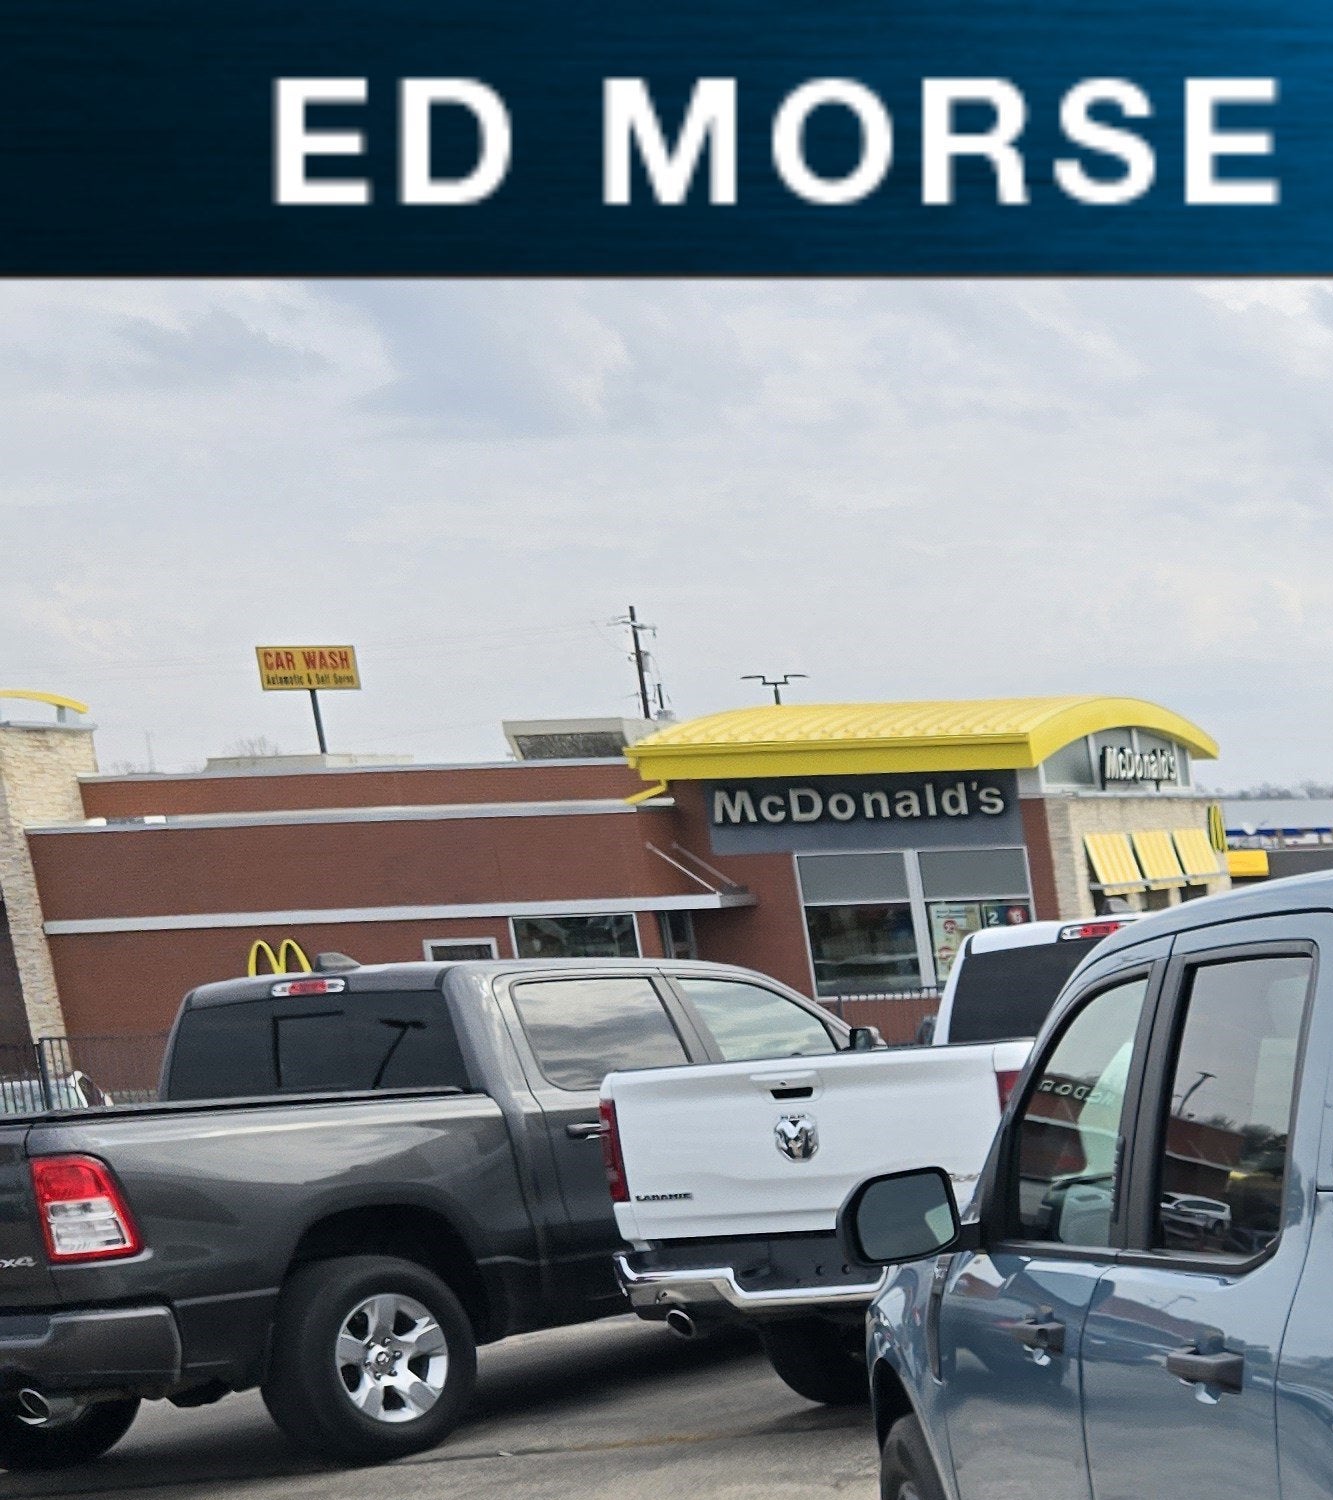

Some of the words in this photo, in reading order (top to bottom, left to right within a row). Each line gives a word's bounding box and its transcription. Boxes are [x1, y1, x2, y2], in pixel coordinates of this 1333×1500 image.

[262, 650, 296, 671] CAR
[300, 649, 351, 670] WASH
[1104, 745, 1178, 782] McDonald's
[713, 781, 1006, 825] McDonald's
[636, 1192, 694, 1202] LARAMIE
